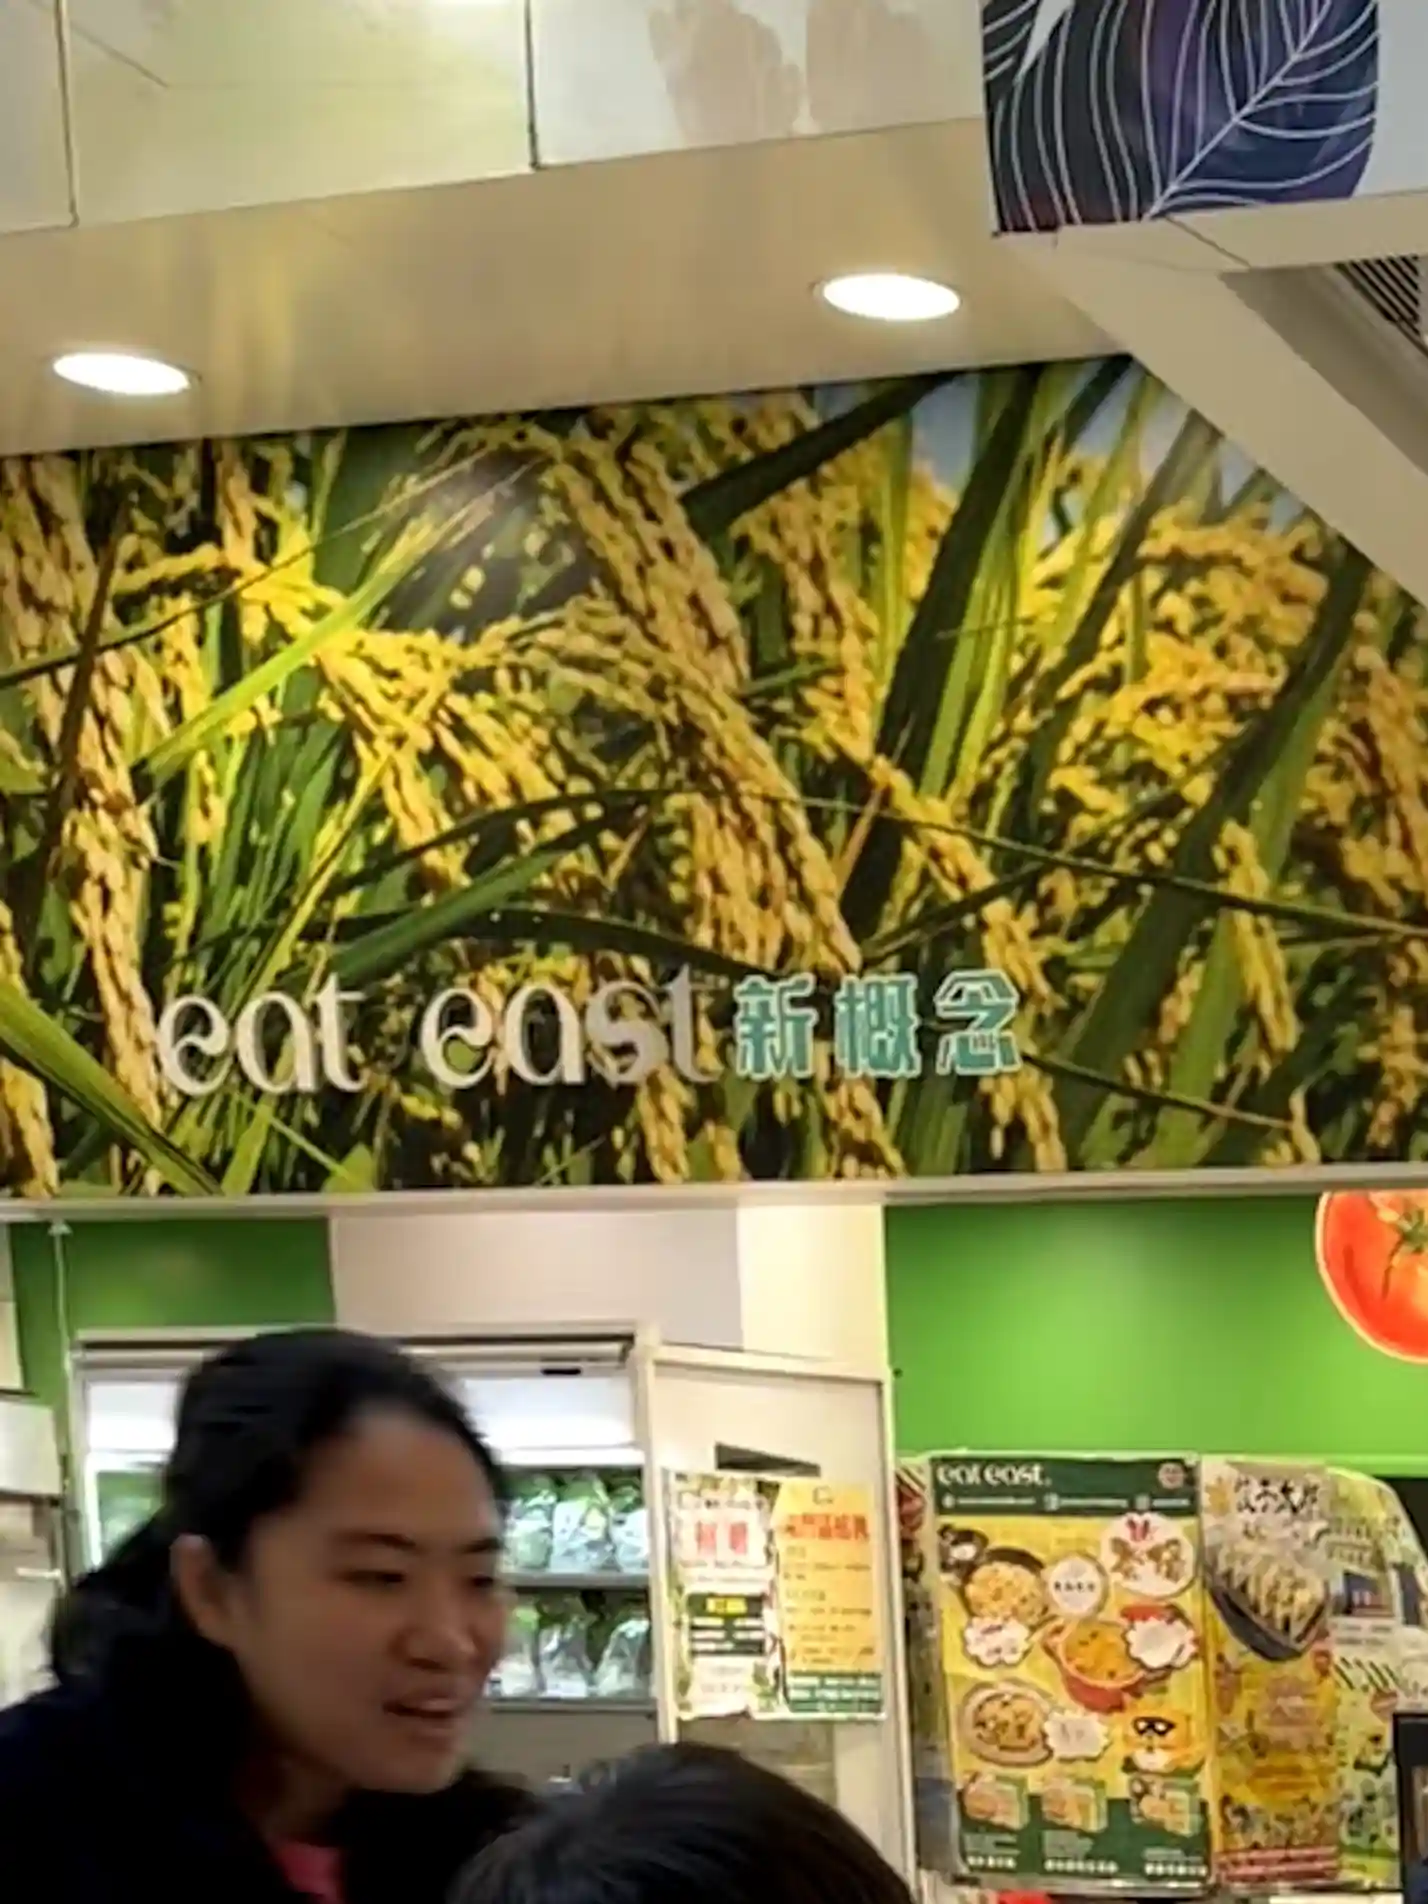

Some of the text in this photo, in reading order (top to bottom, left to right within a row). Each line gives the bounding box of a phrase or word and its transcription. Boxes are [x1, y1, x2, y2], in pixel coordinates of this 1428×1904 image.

[157, 965, 1022, 1096] eat east 新概念
